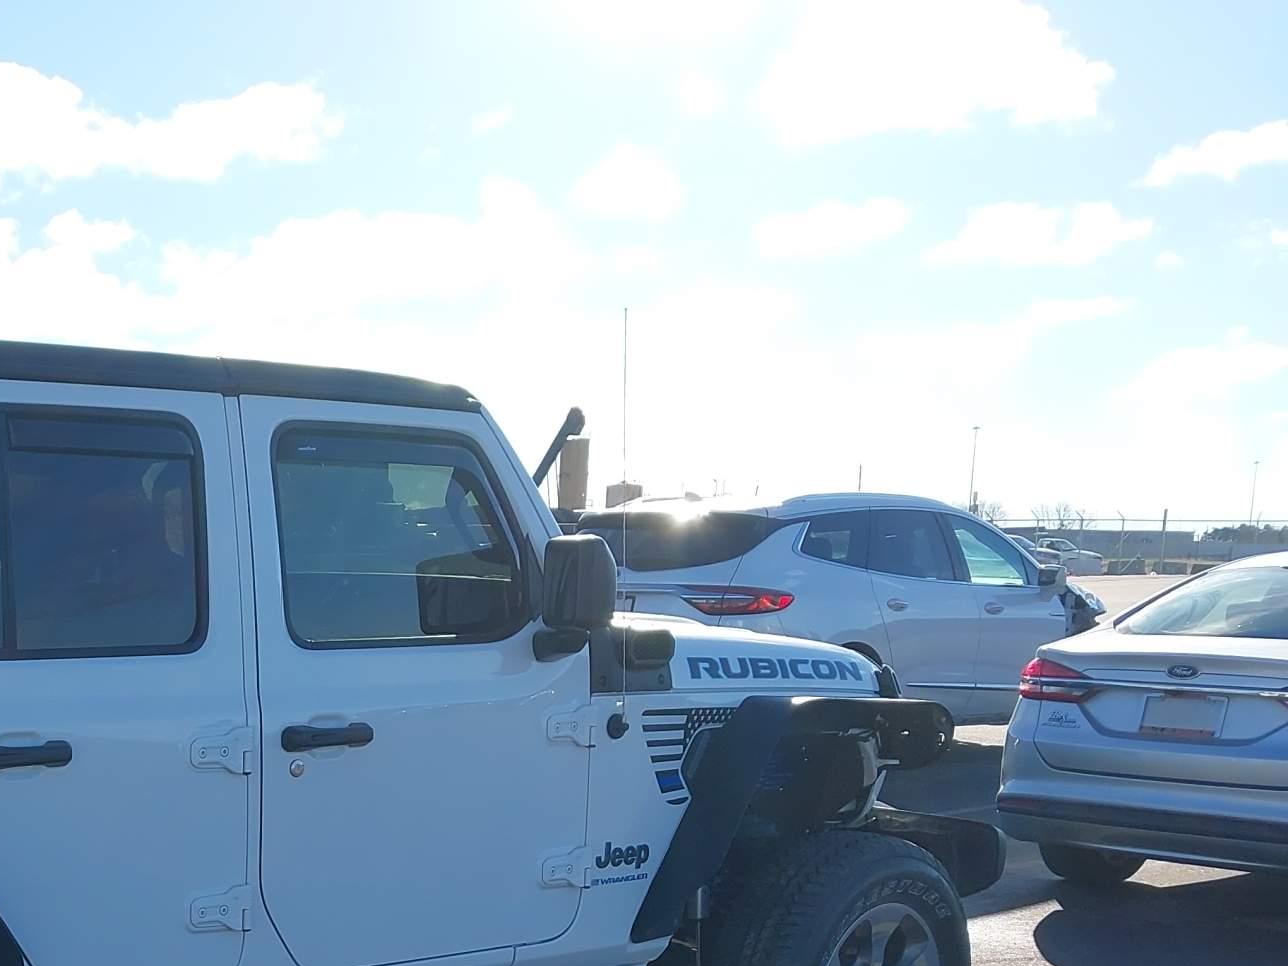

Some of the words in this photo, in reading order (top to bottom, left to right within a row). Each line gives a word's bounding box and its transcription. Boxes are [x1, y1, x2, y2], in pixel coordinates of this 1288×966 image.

[687, 656, 864, 682] RUBICON
[595, 841, 650, 870] Jeep
[600, 872, 648, 885] WRANGLER
